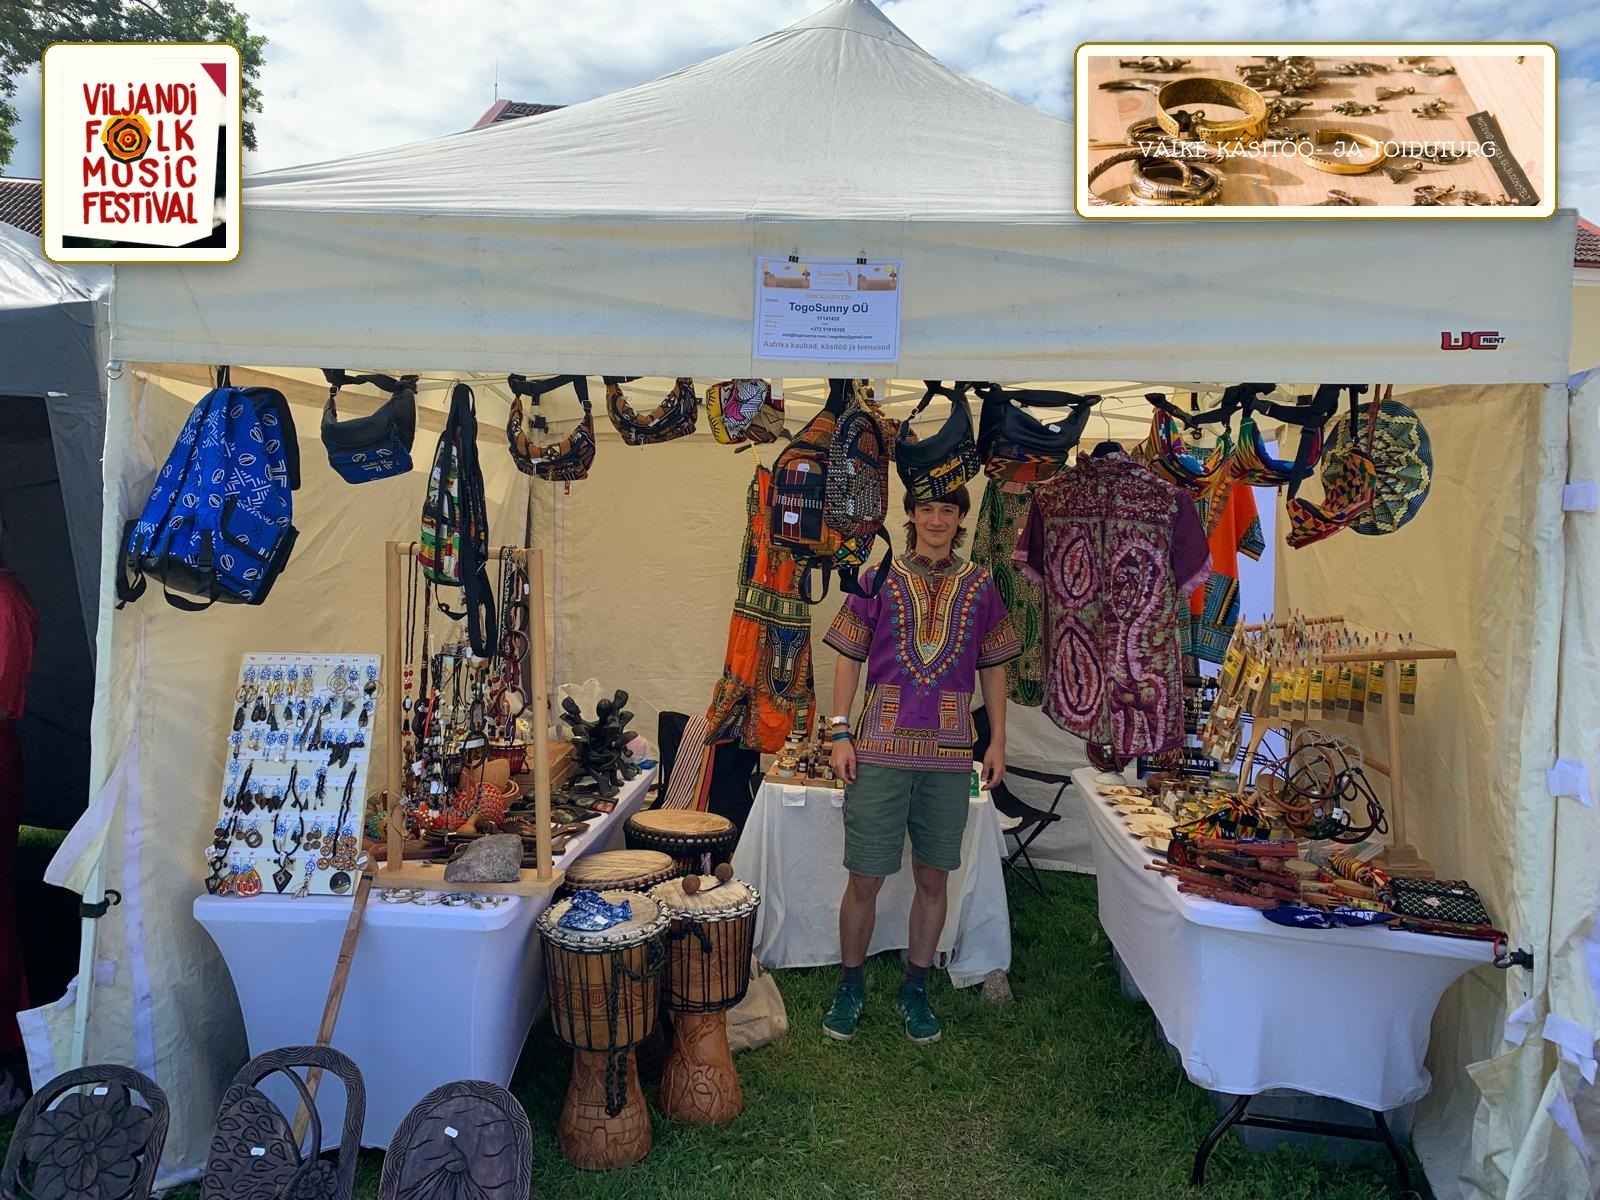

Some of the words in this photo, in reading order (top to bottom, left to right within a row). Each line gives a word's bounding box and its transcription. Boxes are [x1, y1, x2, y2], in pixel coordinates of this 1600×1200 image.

[789, 302, 849, 315] TogoSunny
[852, 302, 869, 313] OÜ
[790, 341, 819, 350] kaubad,
[849, 343, 856, 351] ja
[857, 343, 891, 351] teenused
